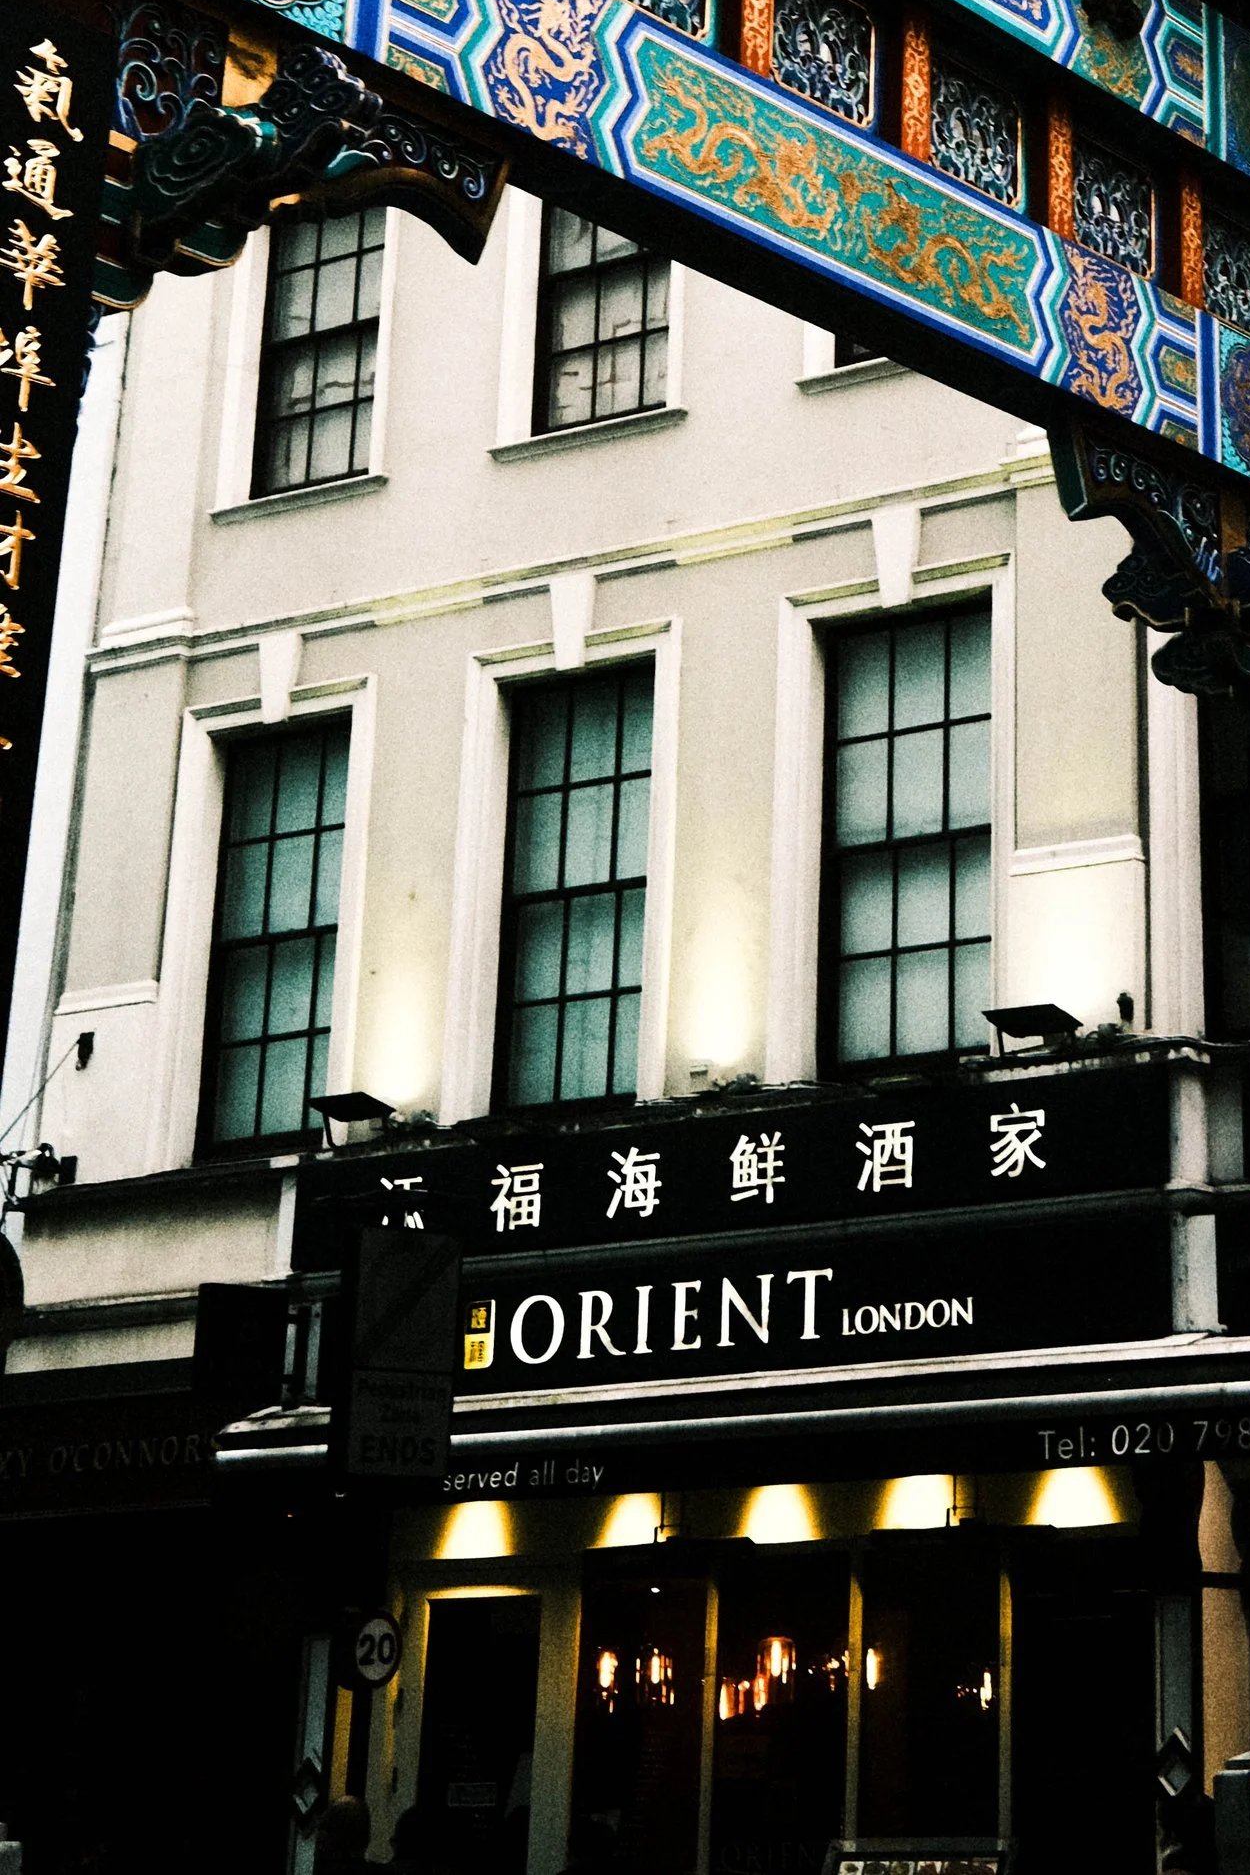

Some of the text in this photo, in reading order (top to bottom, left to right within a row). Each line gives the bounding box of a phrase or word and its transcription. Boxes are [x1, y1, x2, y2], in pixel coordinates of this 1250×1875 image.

[510, 1268, 975, 1364] ORIENT LONDON
[361, 1435, 435, 1466] ENDS
[1037, 1425, 1097, 1461] Tel:
[1111, 1421, 1176, 1456] 020
[442, 1458, 605, 1492] served all day
[358, 1631, 396, 1666] 20
